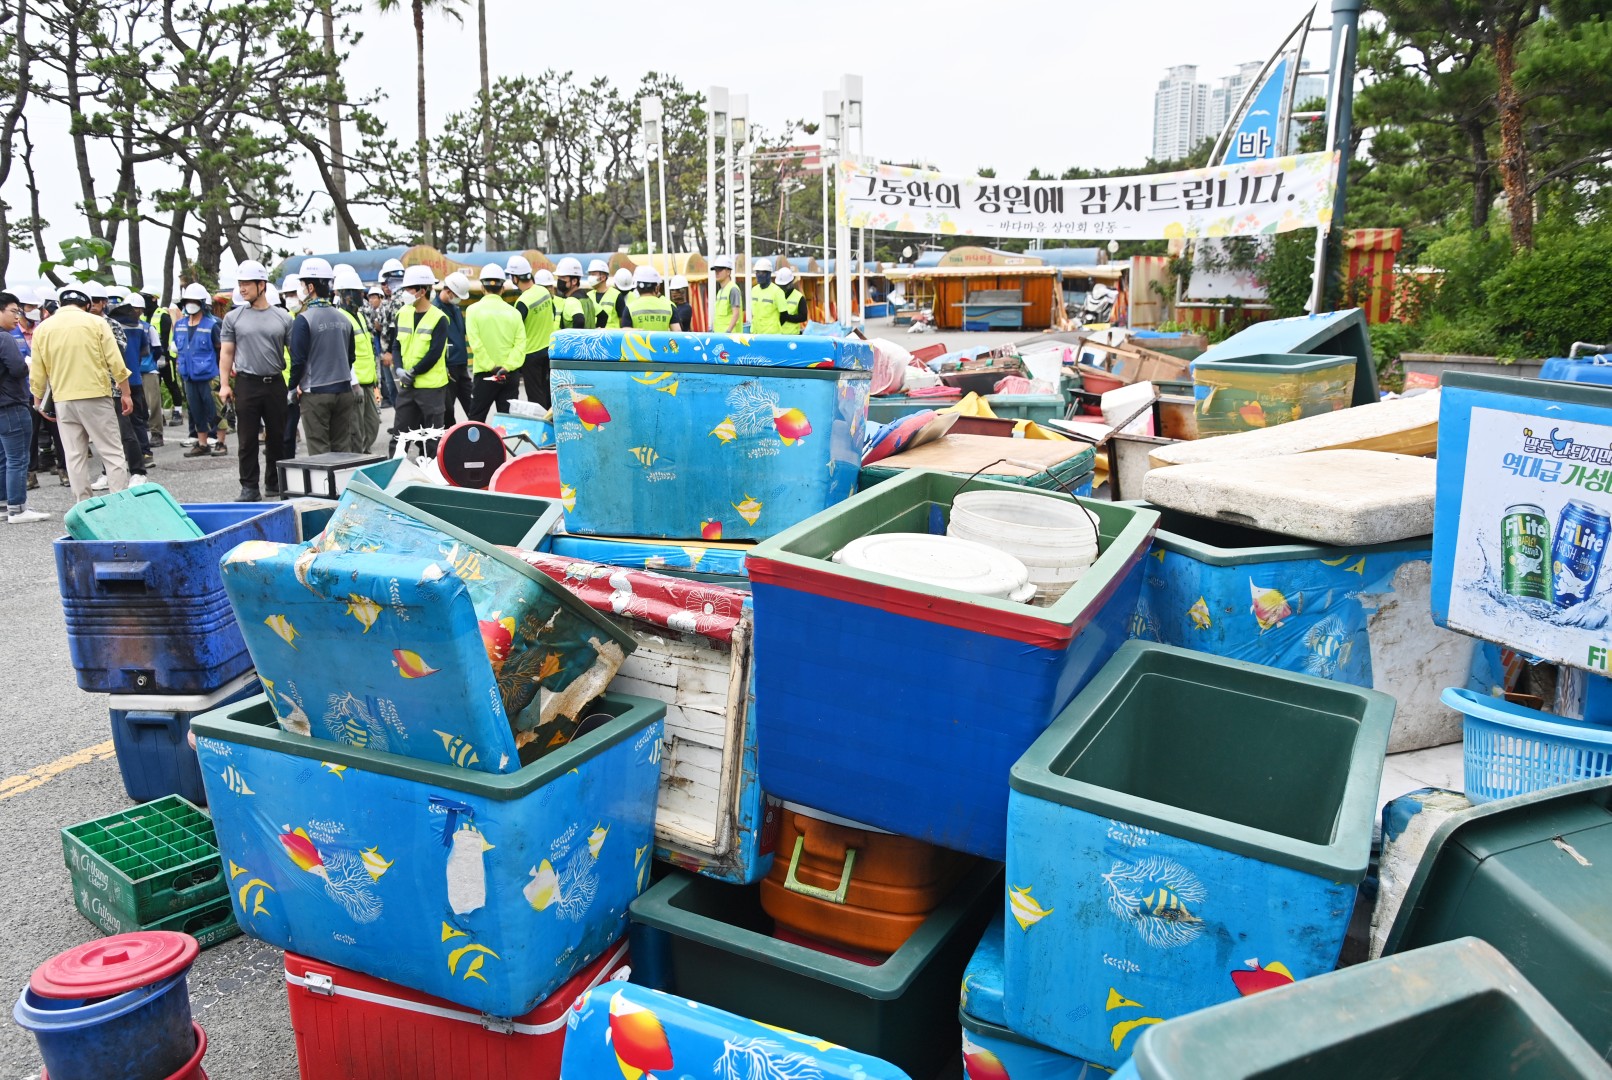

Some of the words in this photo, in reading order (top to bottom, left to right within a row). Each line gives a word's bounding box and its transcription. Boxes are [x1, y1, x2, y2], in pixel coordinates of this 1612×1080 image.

[1237, 126, 1271, 159] 바
[850, 174, 960, 210] 그동안의
[974, 184, 1064, 215] 성원에
[1079, 171, 1296, 215] 감사드립니다.
[1000, 220, 1047, 233] 바다마을
[1052, 220, 1088, 233] 상인회
[1093, 220, 1117, 233] 일동
[1502, 452, 1562, 482] 역대급
[1505, 515, 1548, 538] FiLite
[1560, 519, 1604, 552] FiLite
[1556, 539, 1578, 560] FRESH
[81, 854, 109, 891] Chilsung
